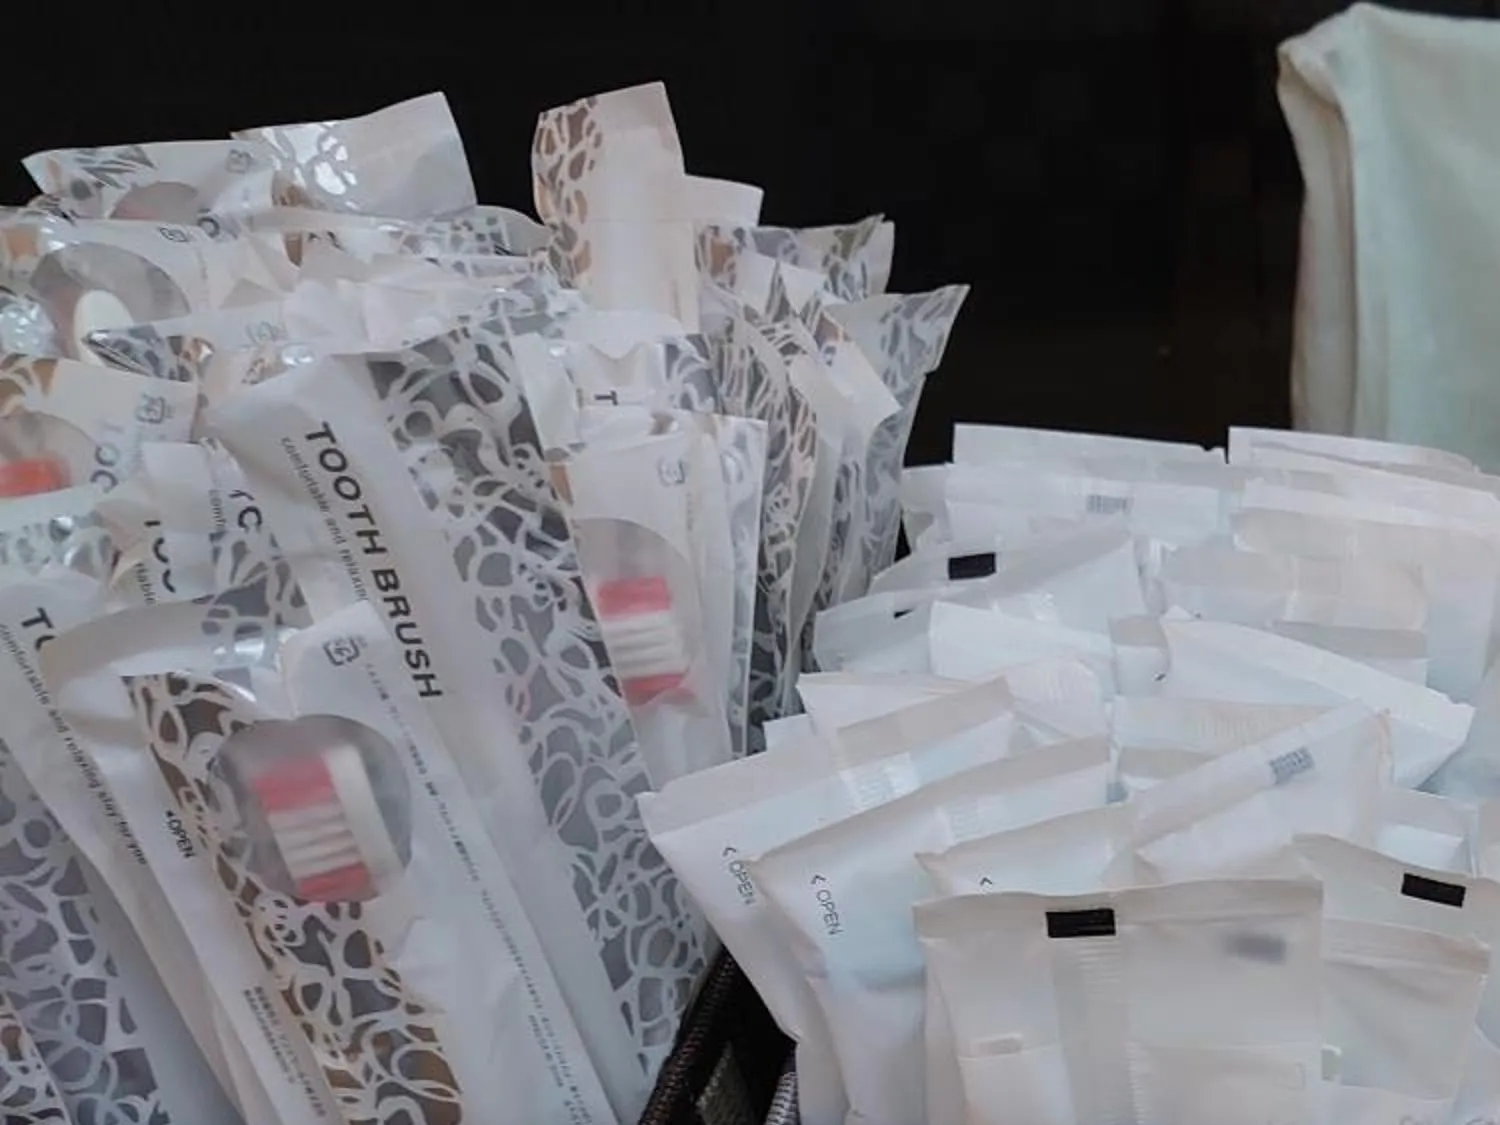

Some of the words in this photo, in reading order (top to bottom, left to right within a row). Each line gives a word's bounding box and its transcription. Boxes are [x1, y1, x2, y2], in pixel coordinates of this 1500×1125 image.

[305, 421, 388, 557] TOOTH
[371, 568, 443, 698] BRUSH
[168, 819, 196, 859] OPEN
[729, 860, 756, 905] OPEN
[816, 889, 843, 935] OPEN
